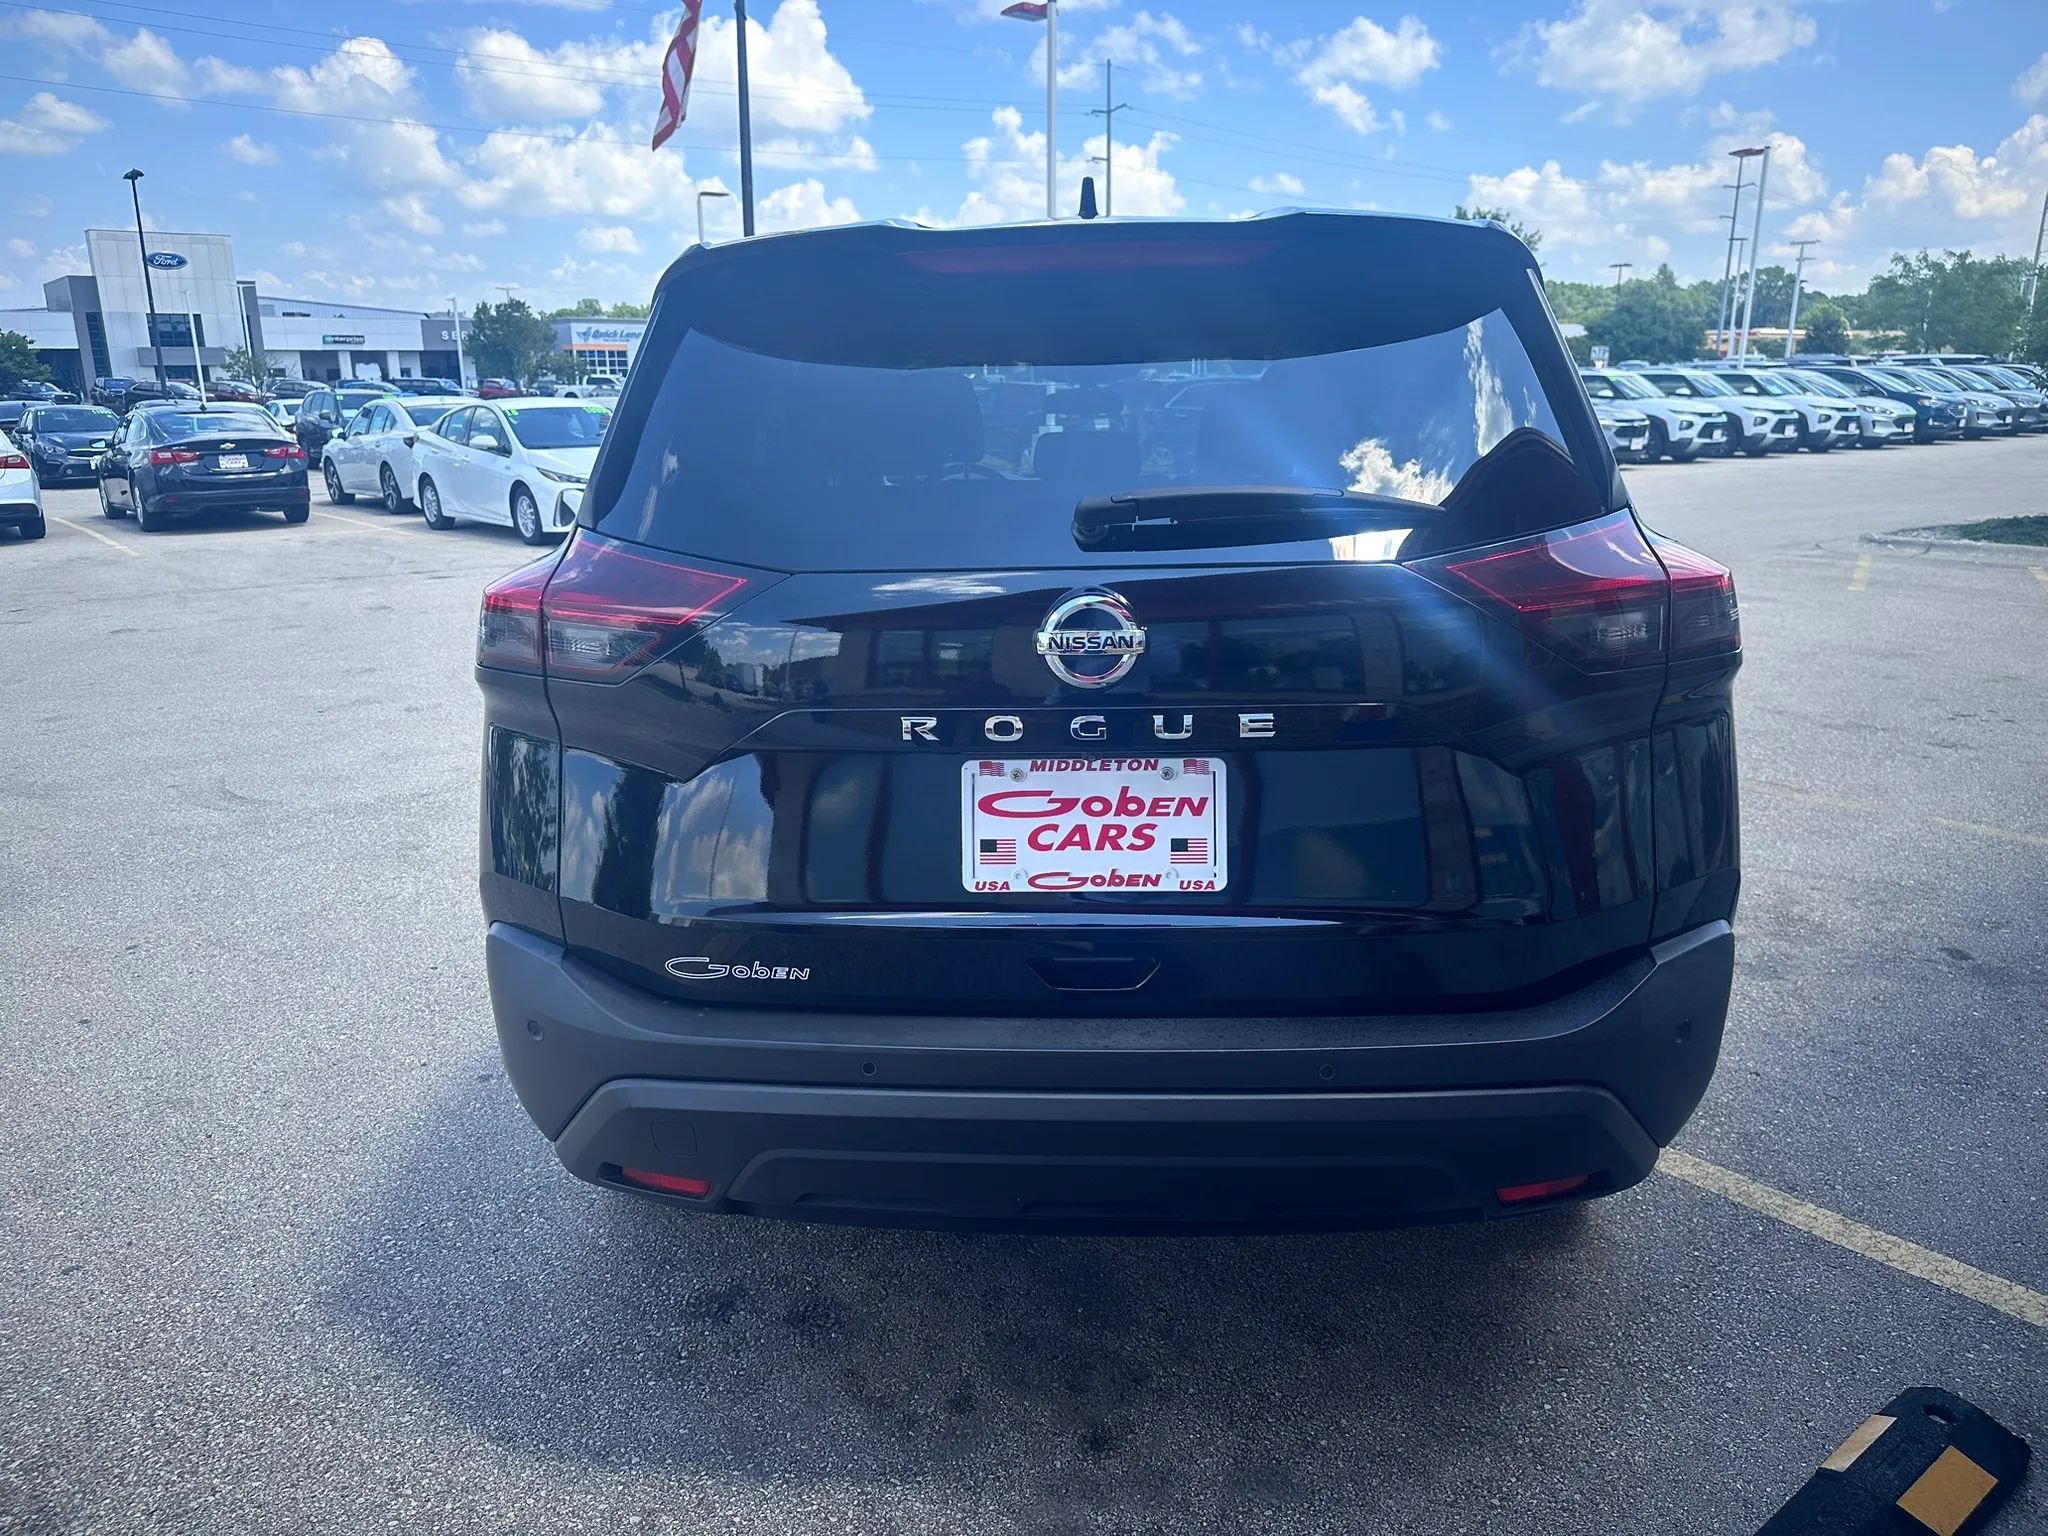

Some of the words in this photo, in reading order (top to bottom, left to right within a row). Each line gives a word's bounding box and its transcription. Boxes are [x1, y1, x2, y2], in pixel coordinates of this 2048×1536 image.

[153, 255, 179, 265] Ford
[592, 329, 618, 339] Quick
[1048, 634, 1134, 650] NISSAN
[900, 713, 1276, 742] ROGUE
[1029, 759, 1159, 772] MIDDLETON
[1027, 823, 1159, 852] CARS
[974, 880, 1011, 891] USA
[1179, 879, 1216, 891] USA
